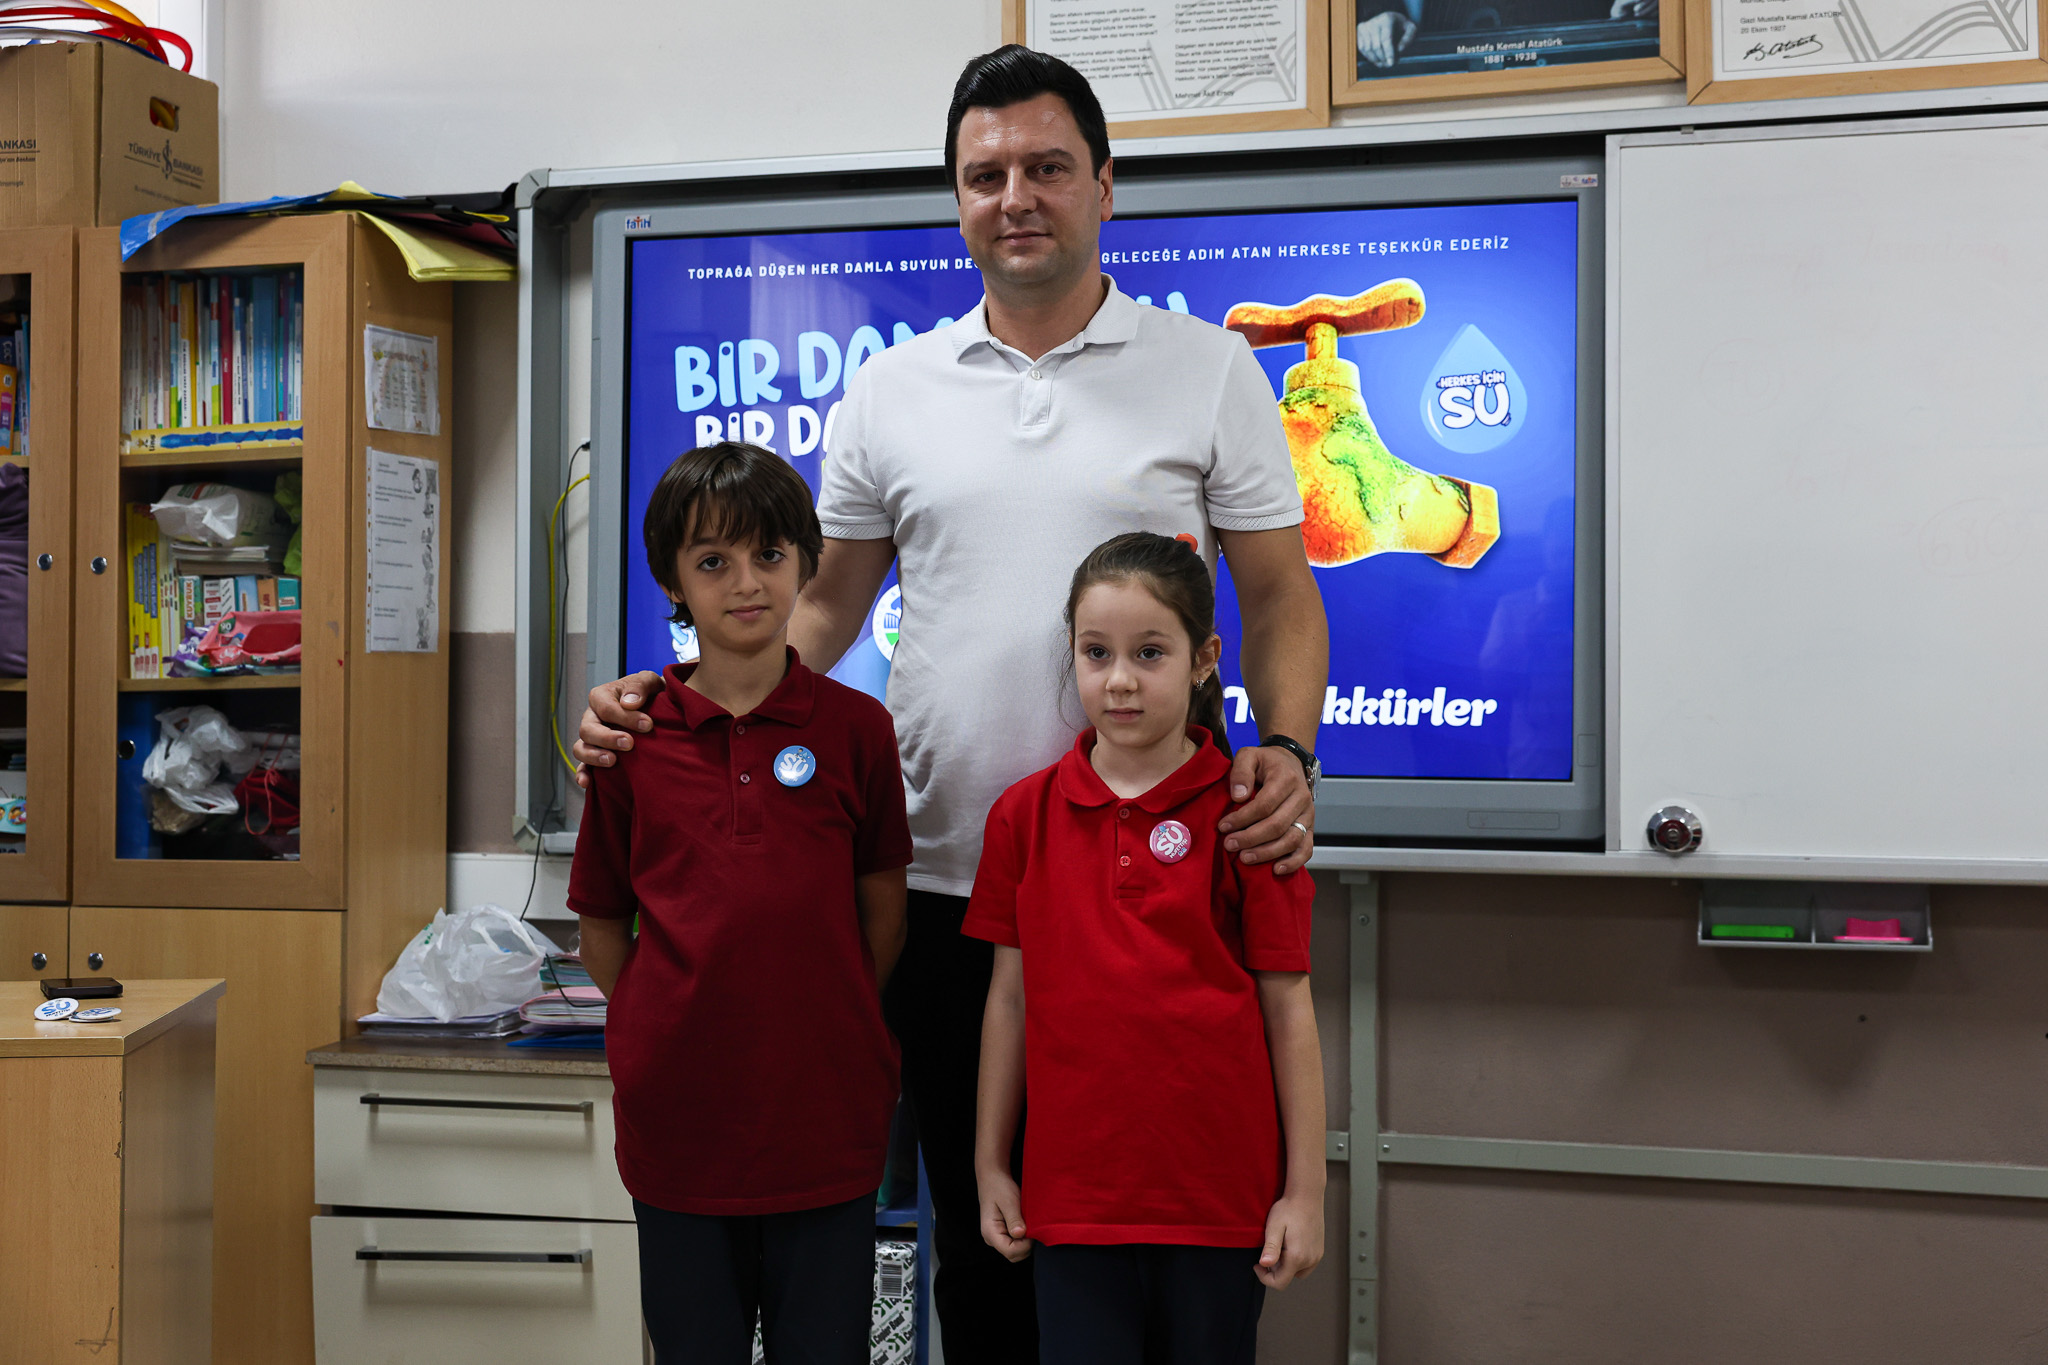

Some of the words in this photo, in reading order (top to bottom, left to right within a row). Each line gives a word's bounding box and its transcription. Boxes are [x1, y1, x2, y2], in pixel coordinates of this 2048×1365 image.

[1757, 15, 1784, 23] Mustafa
[1786, 13, 1807, 21] Kemal
[1457, 43, 1494, 54] Mustafa
[1496, 39, 1526, 51] Kemal
[1528, 37, 1563, 48] Atatürk
[1484, 54, 1504, 64] 1881
[1515, 51, 1537, 62] 1938
[128, 142, 162, 163] TÜRKİYE
[688, 264, 753, 279] TOPRAĞA
[758, 262, 805, 278] DÜŞEN
[811, 263, 839, 275] HER
[844, 261, 894, 274] DAMLA
[900, 258, 948, 271] SUYUN
[1101, 248, 1180, 264] GELECEĞE
[1187, 247, 1225, 261] ADIM
[1232, 245, 1271, 260] ATAN
[1278, 243, 1351, 257] HERKESE
[1358, 238, 1443, 256] TEŞEKKÜR
[1450, 235, 1510, 252] EDERİZ
[675, 338, 782, 413] BİR
[1440, 373, 1481, 388] HERKES
[1481, 369, 1506, 388] İÇİN
[1438, 384, 1511, 429] SU
[185, 582, 194, 619] KUYRUK
[220, 622, 232, 634] 90
[1157, 825, 1184, 856] SU
[41, 1001, 71, 1015] SU
[873, 1325, 892, 1345] Copier
